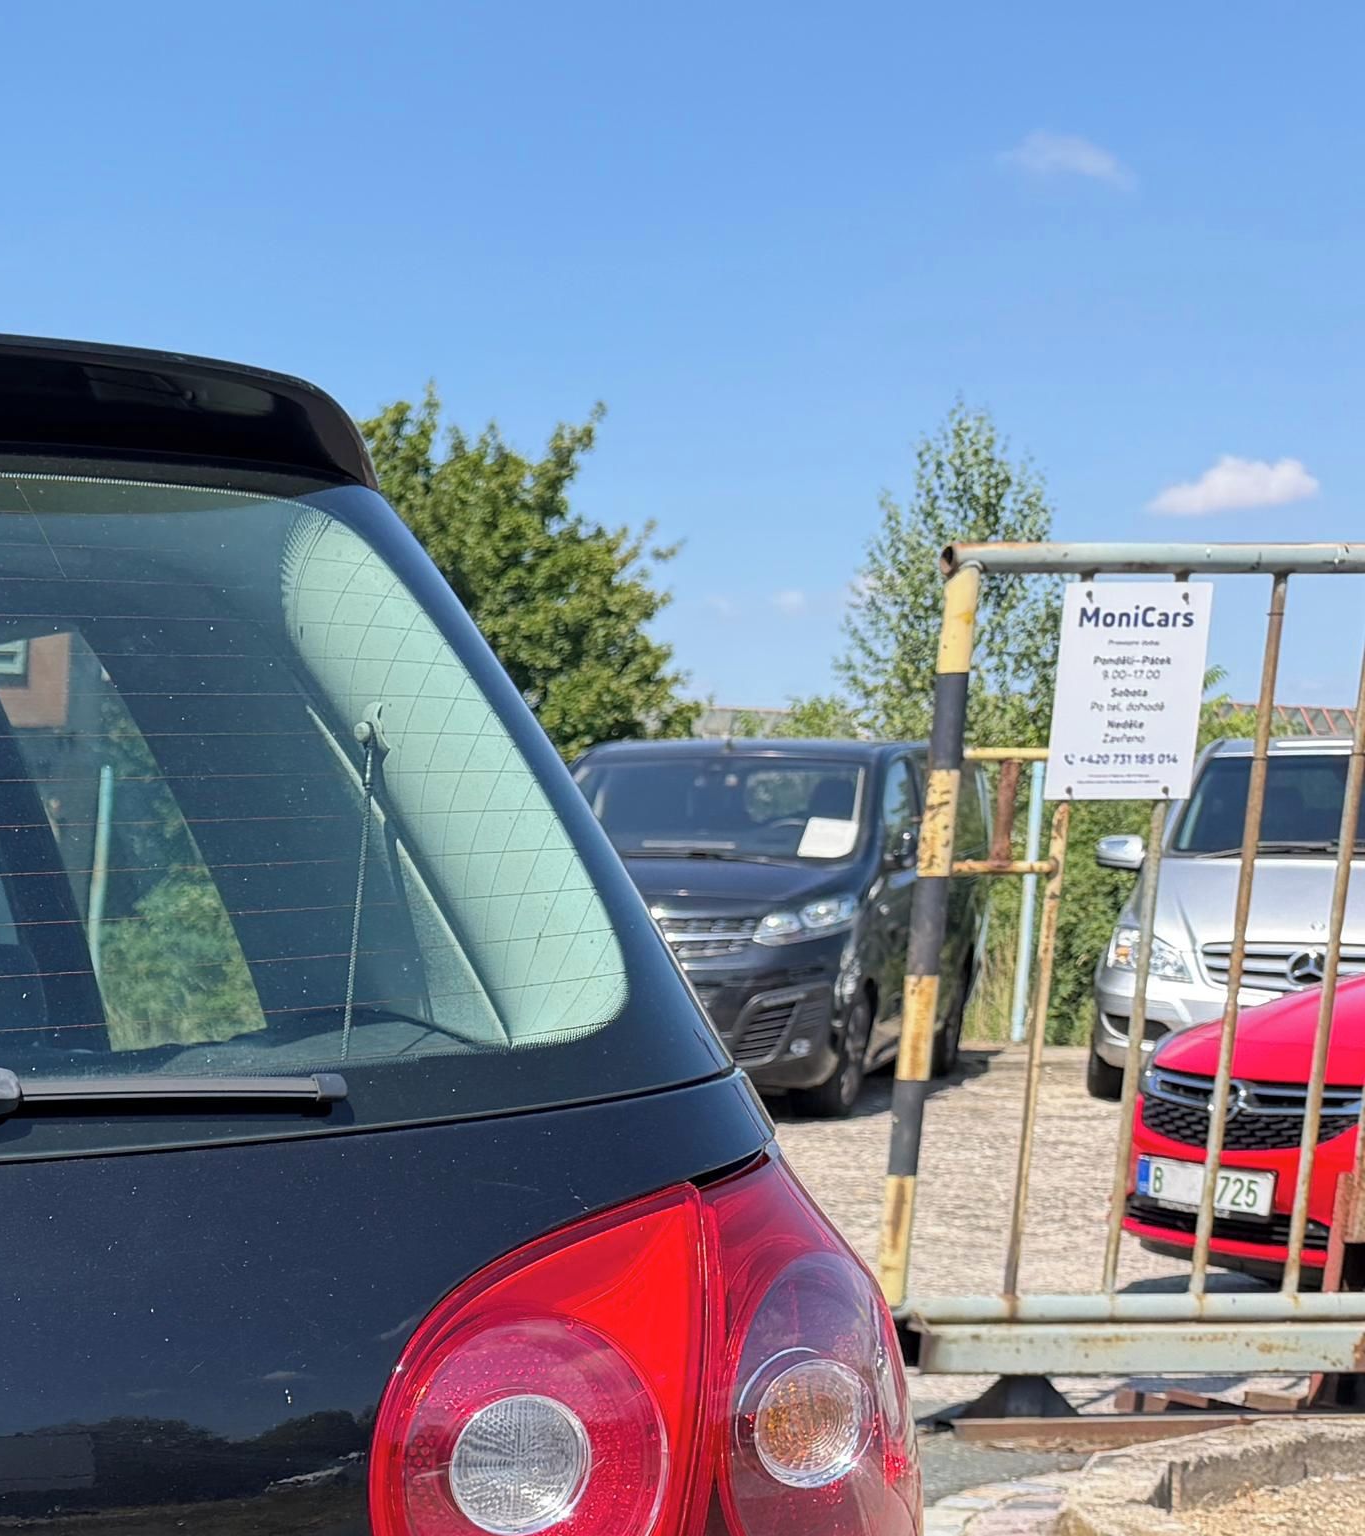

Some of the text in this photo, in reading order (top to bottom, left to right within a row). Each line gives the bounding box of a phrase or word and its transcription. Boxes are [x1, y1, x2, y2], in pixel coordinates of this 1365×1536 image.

[1078, 605, 1195, 628] MoniCars
[1110, 687, 1149, 698] Sobota
[1107, 718, 1144, 730] Neděle
[1079, 753, 1110, 765] +420
